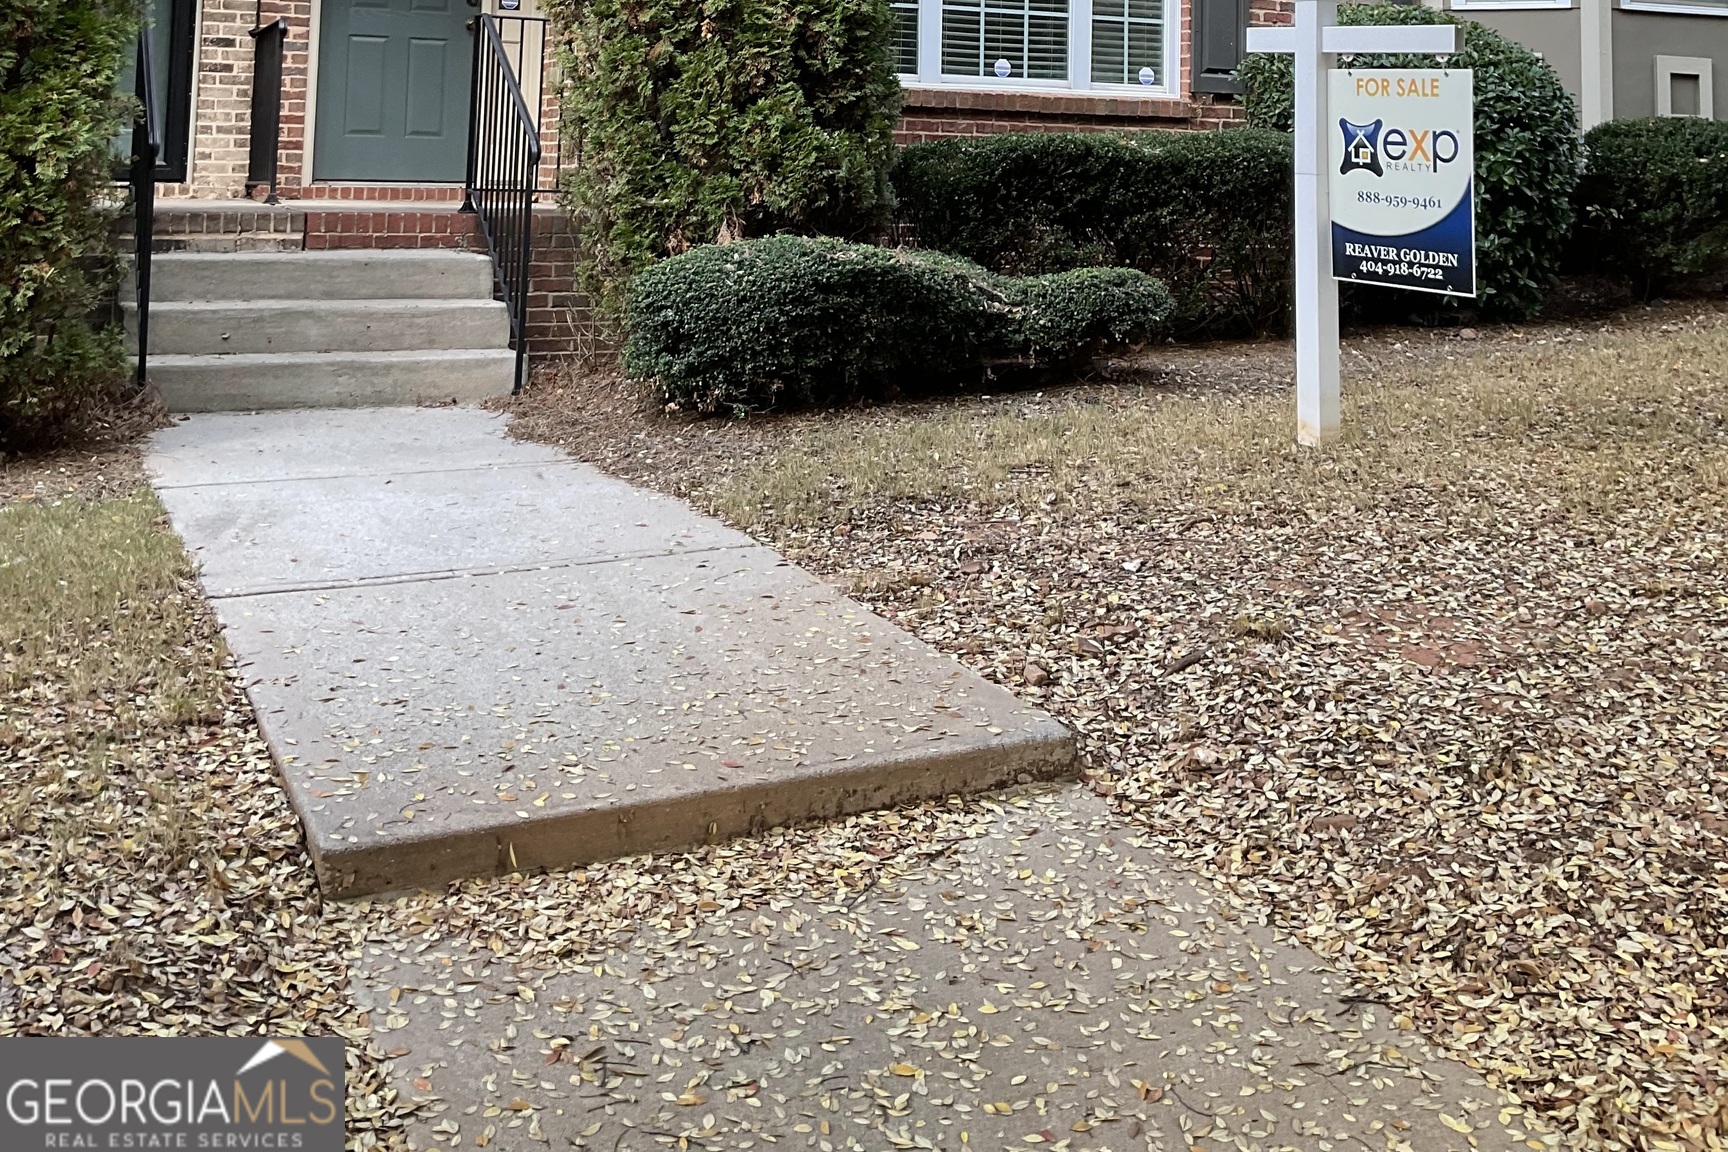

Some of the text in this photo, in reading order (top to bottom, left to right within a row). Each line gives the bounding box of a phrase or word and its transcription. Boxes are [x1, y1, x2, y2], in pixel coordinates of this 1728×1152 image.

[1356, 77, 1440, 98] FOR SALE
[1382, 128, 1459, 173] exp
[1386, 161, 1431, 173] REALTY
[1357, 190, 1442, 210] 888-959-9461
[1344, 242, 1459, 267] REAVER GOLDEN
[1359, 260, 1444, 280] 404-918-6722
